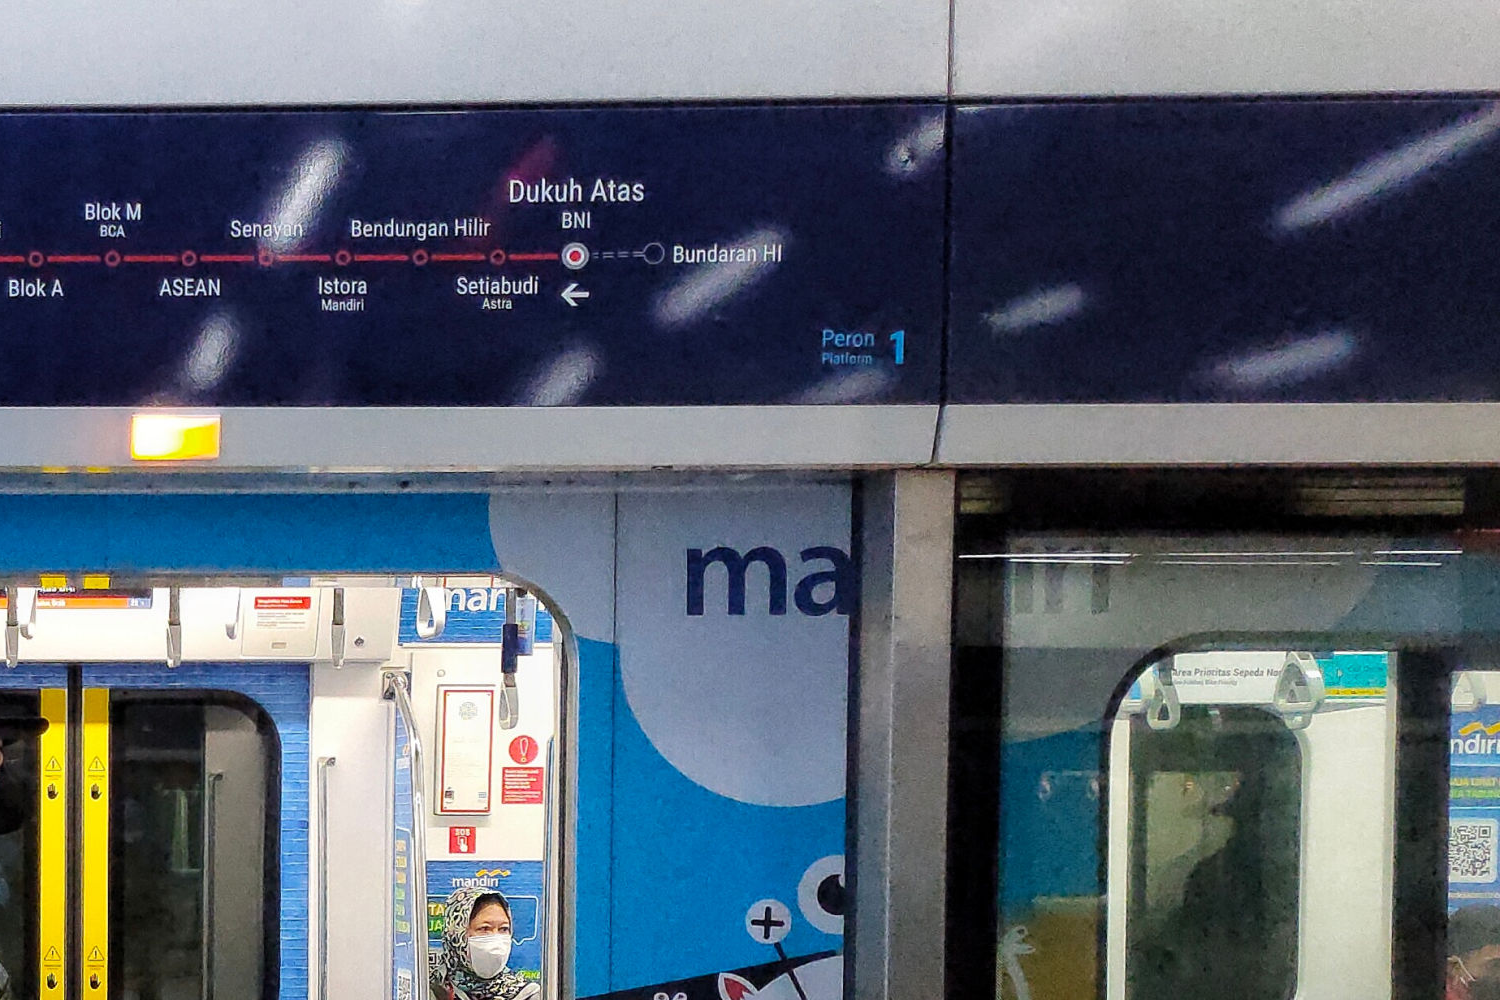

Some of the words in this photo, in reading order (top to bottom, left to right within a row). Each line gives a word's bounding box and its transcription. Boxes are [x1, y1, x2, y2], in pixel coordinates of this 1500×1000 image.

[509, 179, 584, 203] Dukuh
[590, 179, 645, 203] Atas
[85, 203, 120, 222] Blok
[124, 203, 142, 222] M
[561, 213, 592, 231] BNI
[99, 225, 126, 239] BCA
[230, 220, 303, 243] Senayan
[350, 218, 449, 243] Bendungan
[454, 218, 491, 238] Hilir
[672, 244, 757, 265] Bundaran
[763, 244, 784, 264] HI
[8, 279, 43, 298] Blok
[47, 279, 64, 298] A
[159, 279, 222, 298] ASEAN
[318, 276, 368, 297] Istora
[456, 276, 539, 297] Setiabudi
[321, 298, 365, 312] Mandiri
[482, 297, 512, 311] Astra
[822, 329, 875, 349] Peron
[890, 330, 905, 364] 1
[822, 352, 873, 366] Platform
[686, 545, 850, 616] ma
[1233, 667, 1264, 679] Sepeda
[1450, 733, 1500, 754] ndiri
